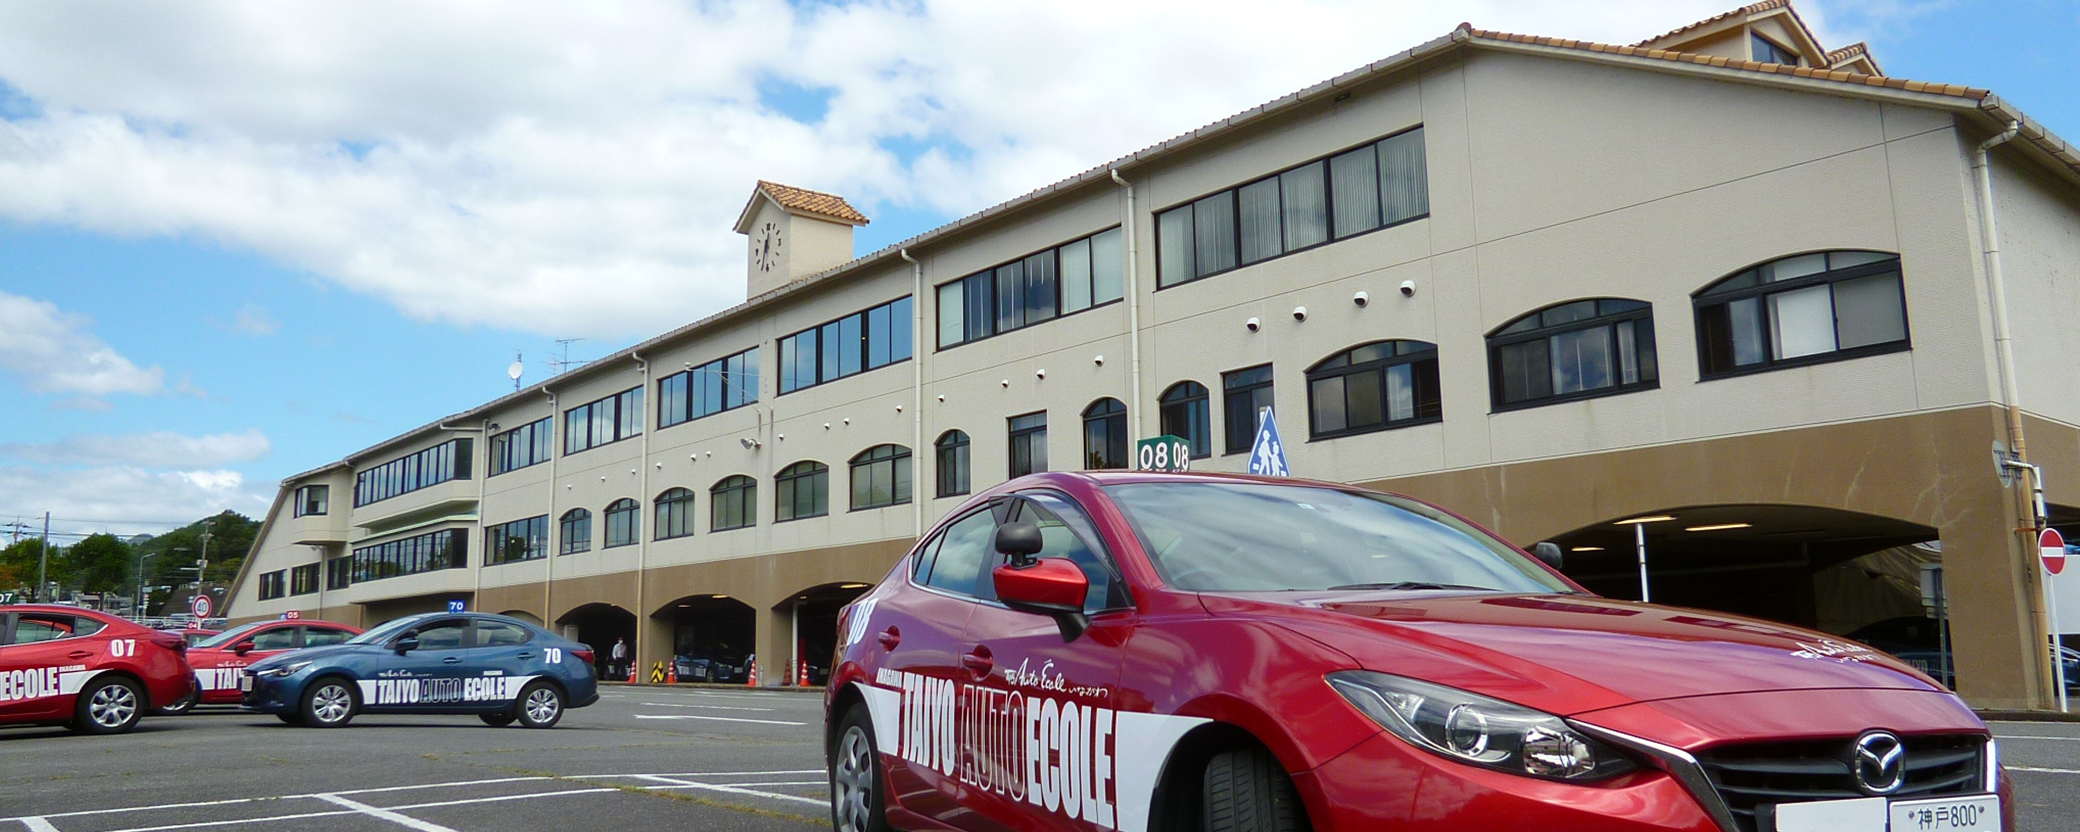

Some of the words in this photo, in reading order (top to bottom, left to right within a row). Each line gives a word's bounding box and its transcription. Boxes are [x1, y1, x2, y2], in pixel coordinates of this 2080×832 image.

[1141, 441, 1168, 469] 08
[1173, 441, 1188, 471] 08
[196, 602, 207, 613] 40
[287, 611, 299, 619] 05
[449, 602, 464, 610] 70
[111, 639, 136, 657] 07
[543, 648, 561, 664] 70
[0, 667, 59, 701] ECOLE
[378, 679, 420, 704] TAIYO
[420, 678, 461, 704] AUTO
[464, 677, 505, 701] ECOLE
[901, 672, 955, 777] TAIYO
[960, 684, 1026, 803] AUTO
[1026, 697, 1116, 830] ECOLE
